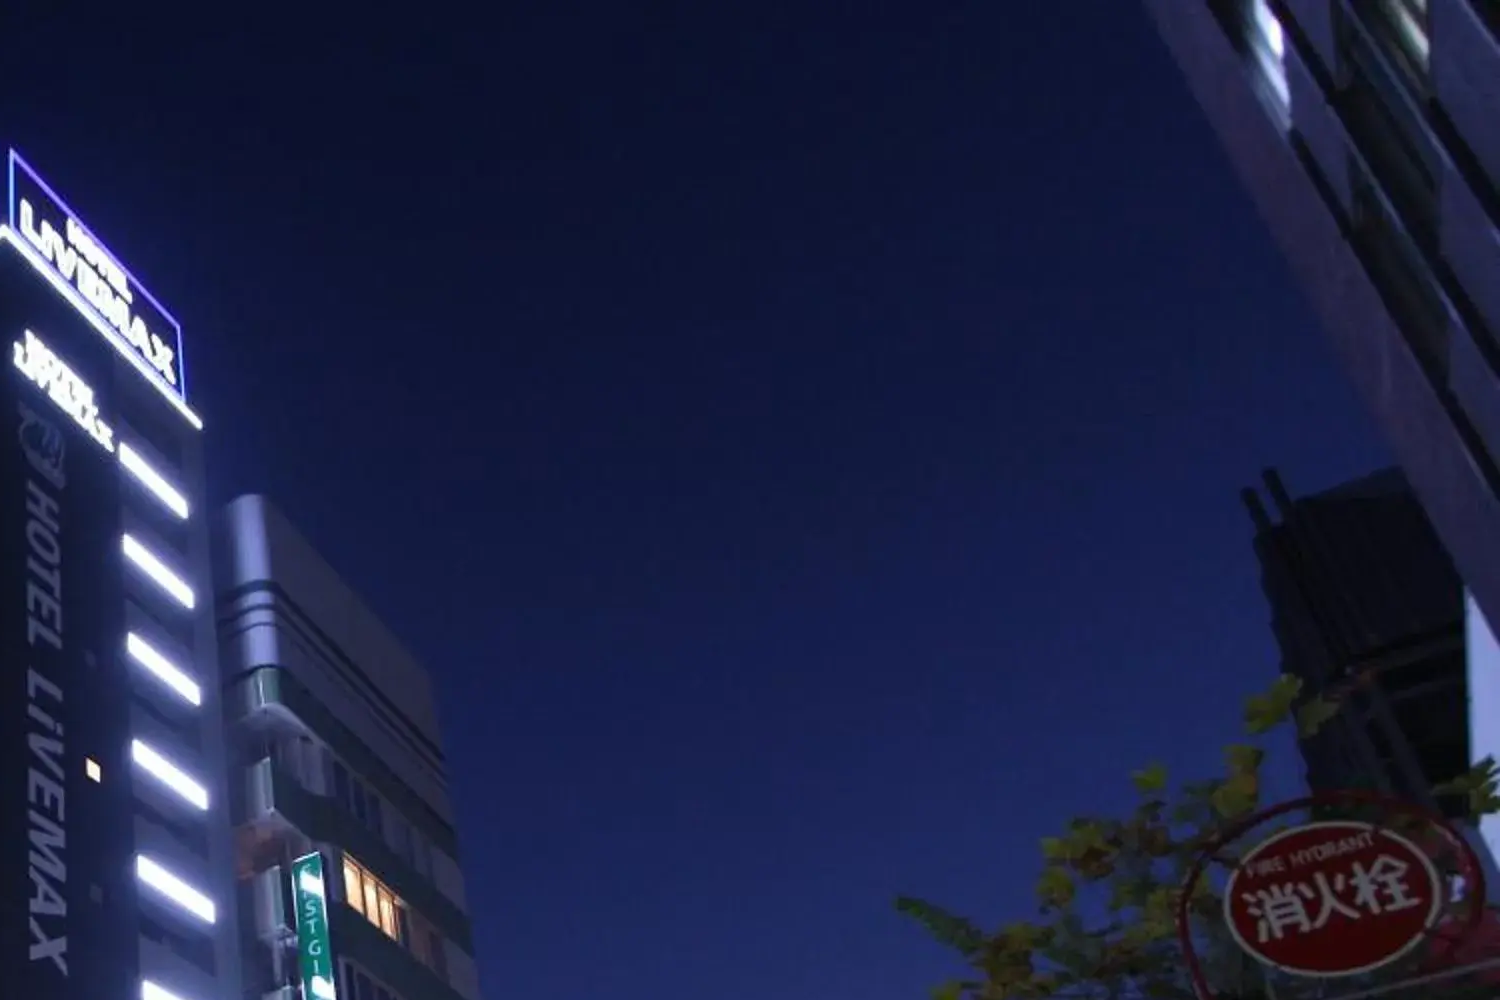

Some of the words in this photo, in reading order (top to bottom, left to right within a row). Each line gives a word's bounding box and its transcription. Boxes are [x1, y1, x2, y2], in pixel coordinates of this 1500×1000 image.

[25, 480, 63, 650] HOTEL
[1241, 853, 1422, 943] 消火栓
[1245, 855, 1287, 879] FIRE
[1288, 831, 1375, 869] HYDRANT
